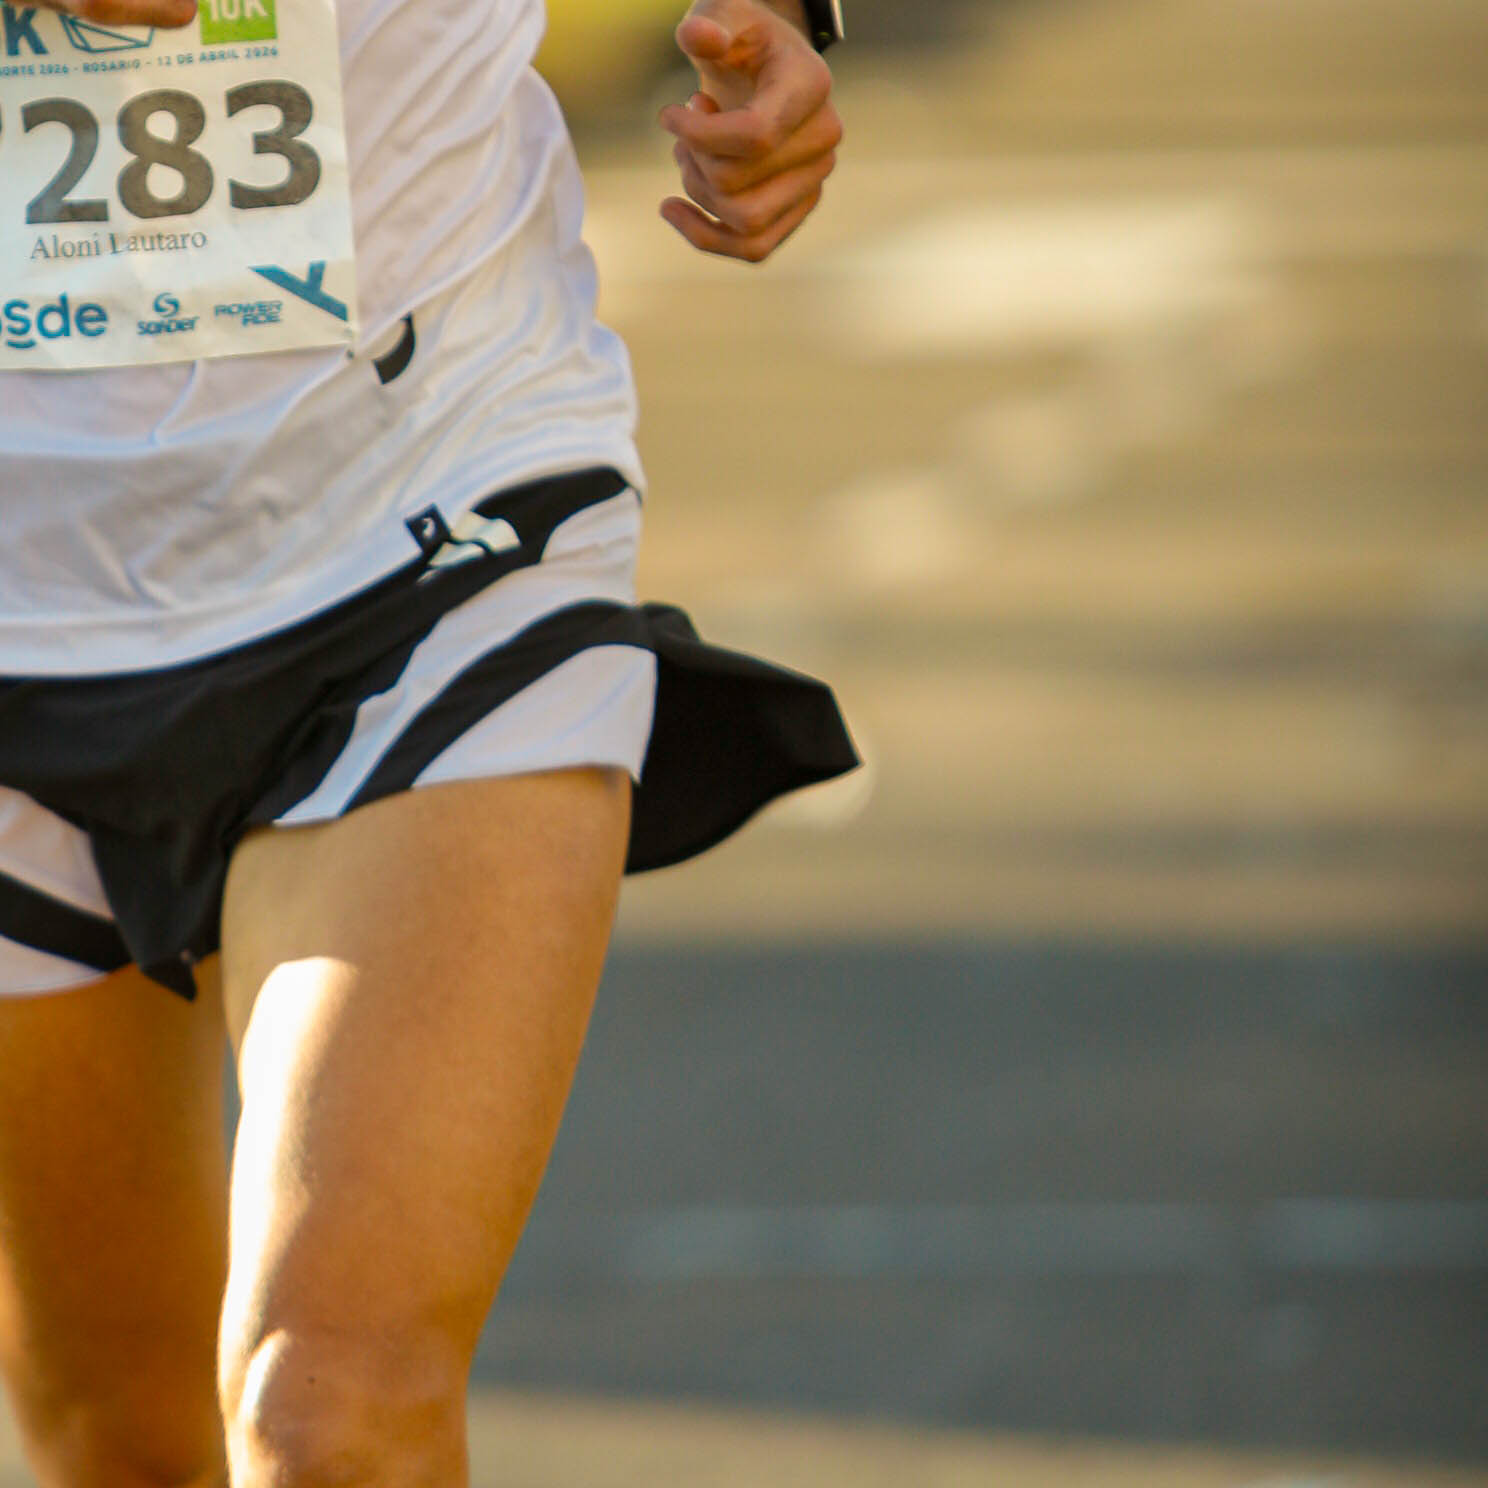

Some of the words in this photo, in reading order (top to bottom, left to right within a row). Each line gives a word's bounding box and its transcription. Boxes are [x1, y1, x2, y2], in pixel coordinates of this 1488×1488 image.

[82, 59, 141, 73] ROSARIO
[176, 53, 193, 65] DE
[199, 49, 240, 62] ABRIL
[29, 234, 101, 261] Aloni
[110, 230, 208, 256] Lautaro
